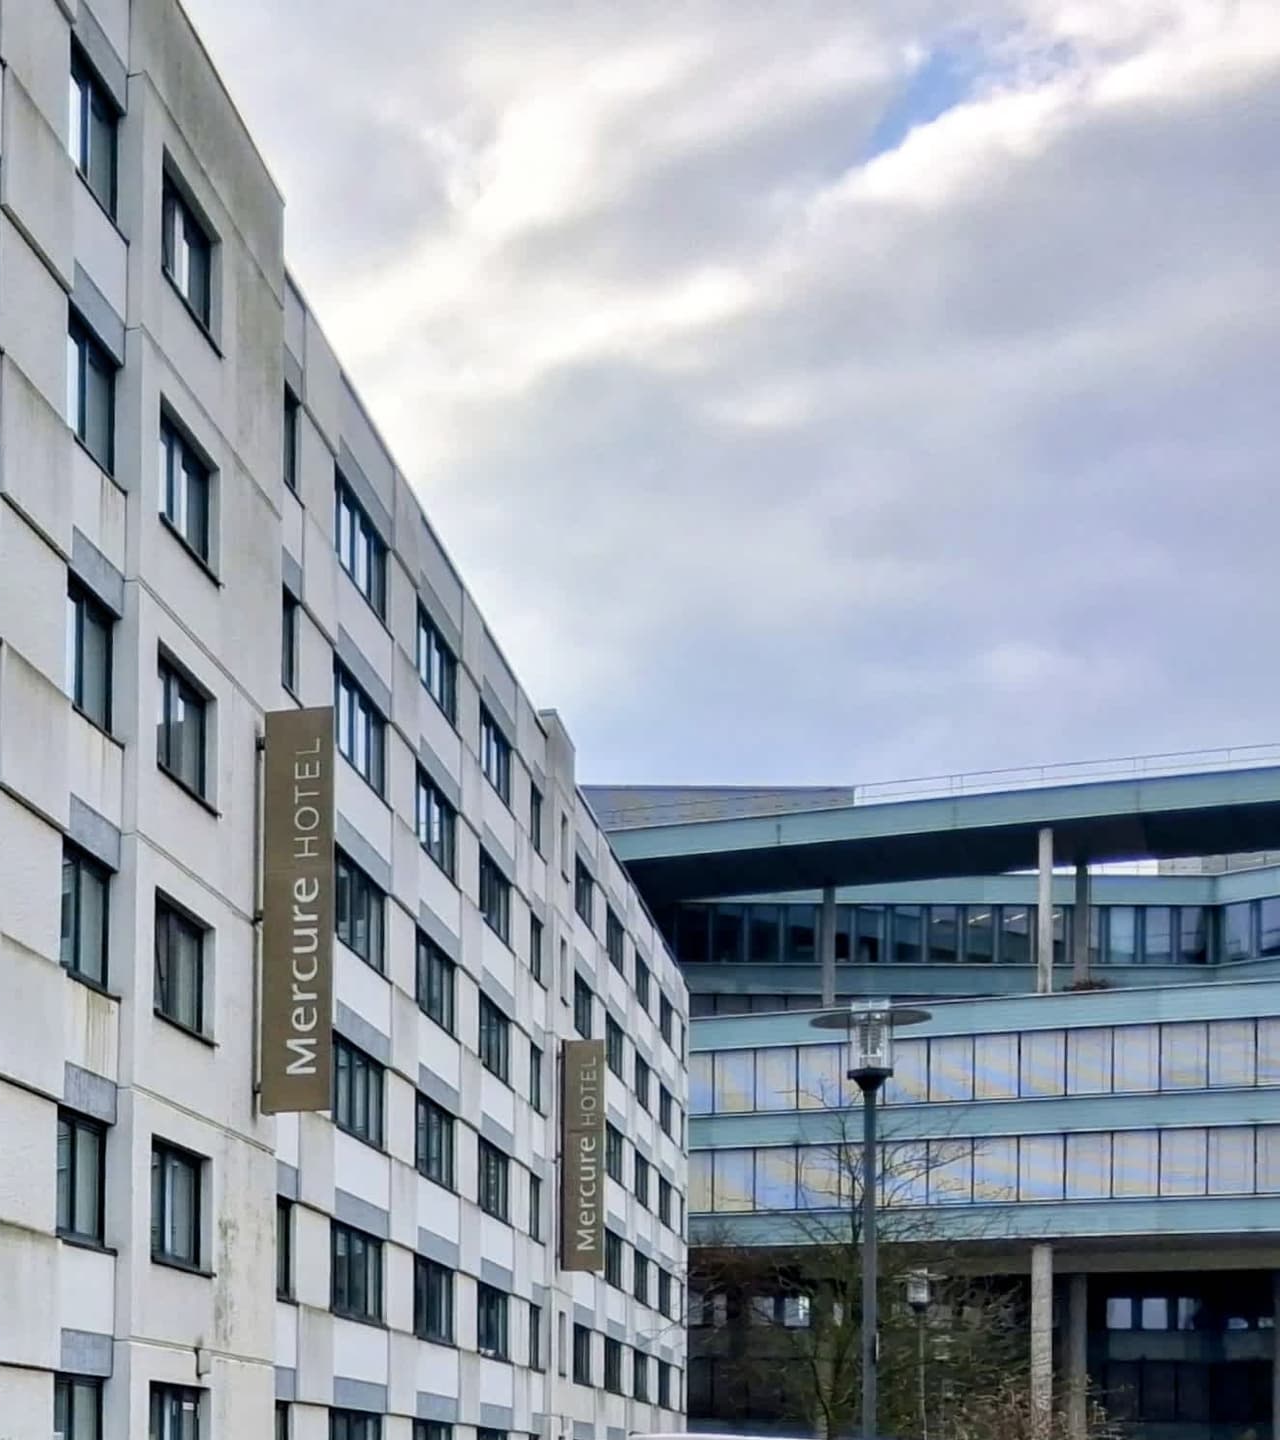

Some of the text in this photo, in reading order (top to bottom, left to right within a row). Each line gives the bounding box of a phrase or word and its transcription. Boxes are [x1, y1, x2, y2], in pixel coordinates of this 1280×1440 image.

[286, 736, 322, 1076] Mercure HOTEL
[576, 1056, 597, 1251] Mercure HOTEL
